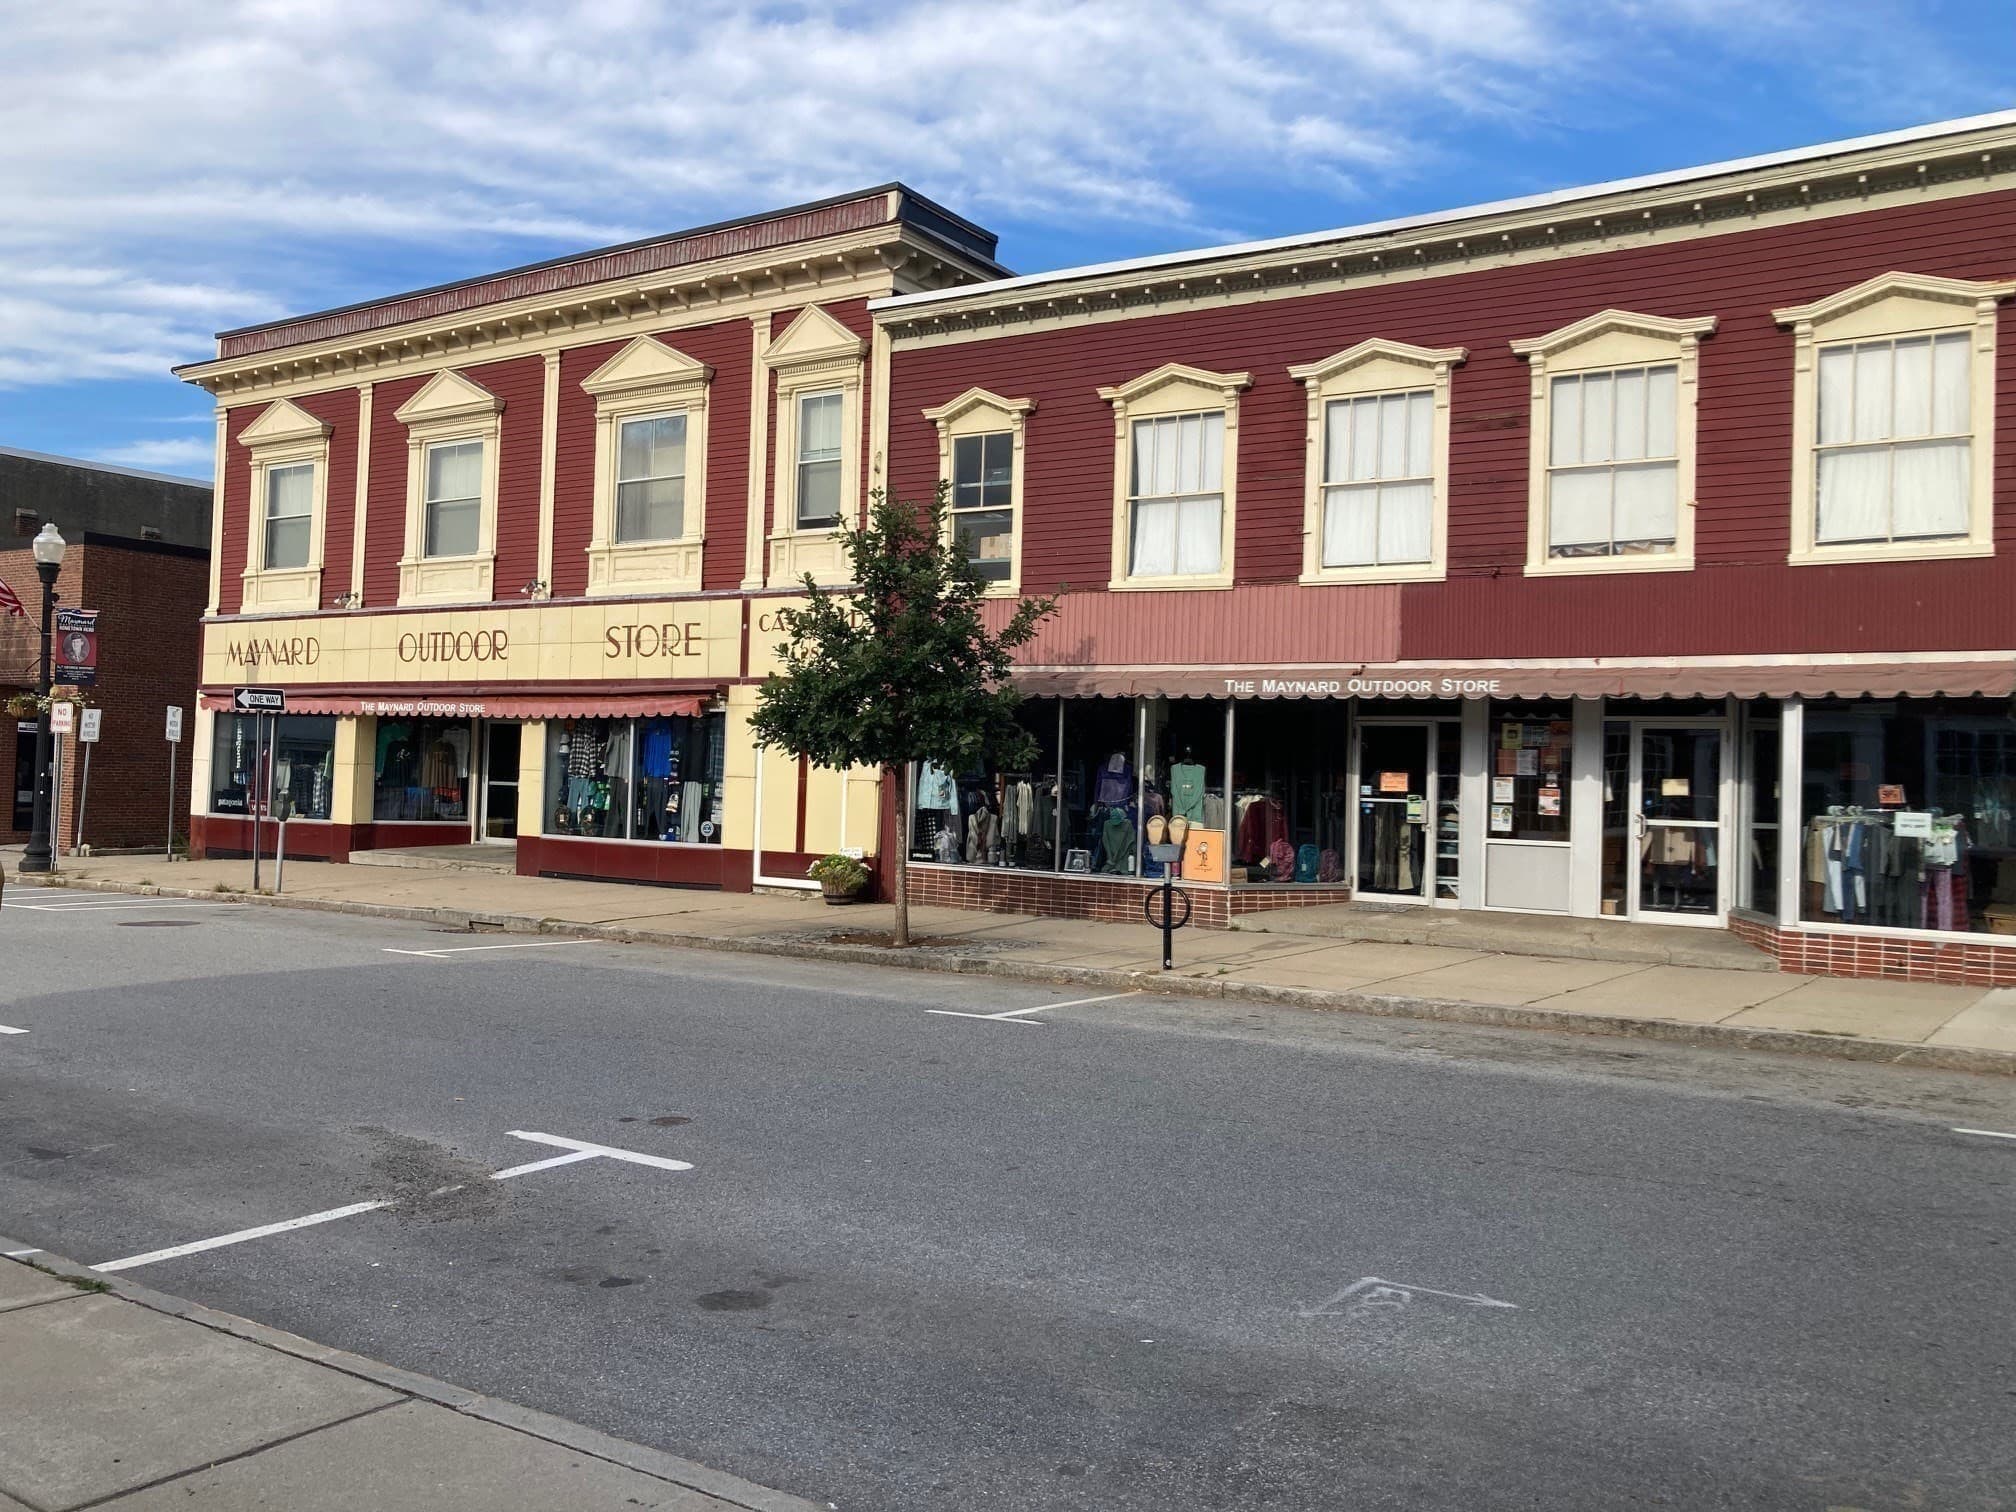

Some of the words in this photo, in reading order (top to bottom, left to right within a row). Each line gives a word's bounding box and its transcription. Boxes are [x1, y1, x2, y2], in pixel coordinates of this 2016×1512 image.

[226, 637, 320, 666] MAYNARD
[398, 630, 508, 662] OUTDOOR
[605, 623, 702, 658] STORE
[1224, 679, 1255, 693] THE
[1262, 679, 1340, 693] MAYNARD
[1347, 679, 1433, 692] OUTDOOR
[1440, 678, 1501, 692] STORE
[249, 694, 264, 703] ONE
[265, 695, 280, 704] WAY
[58, 708, 67, 716] NO
[360, 701, 375, 711] THE
[377, 701, 414, 712] MAYNARD
[417, 702, 456, 712] OUTDOOR
[459, 702, 486, 713] STORE
